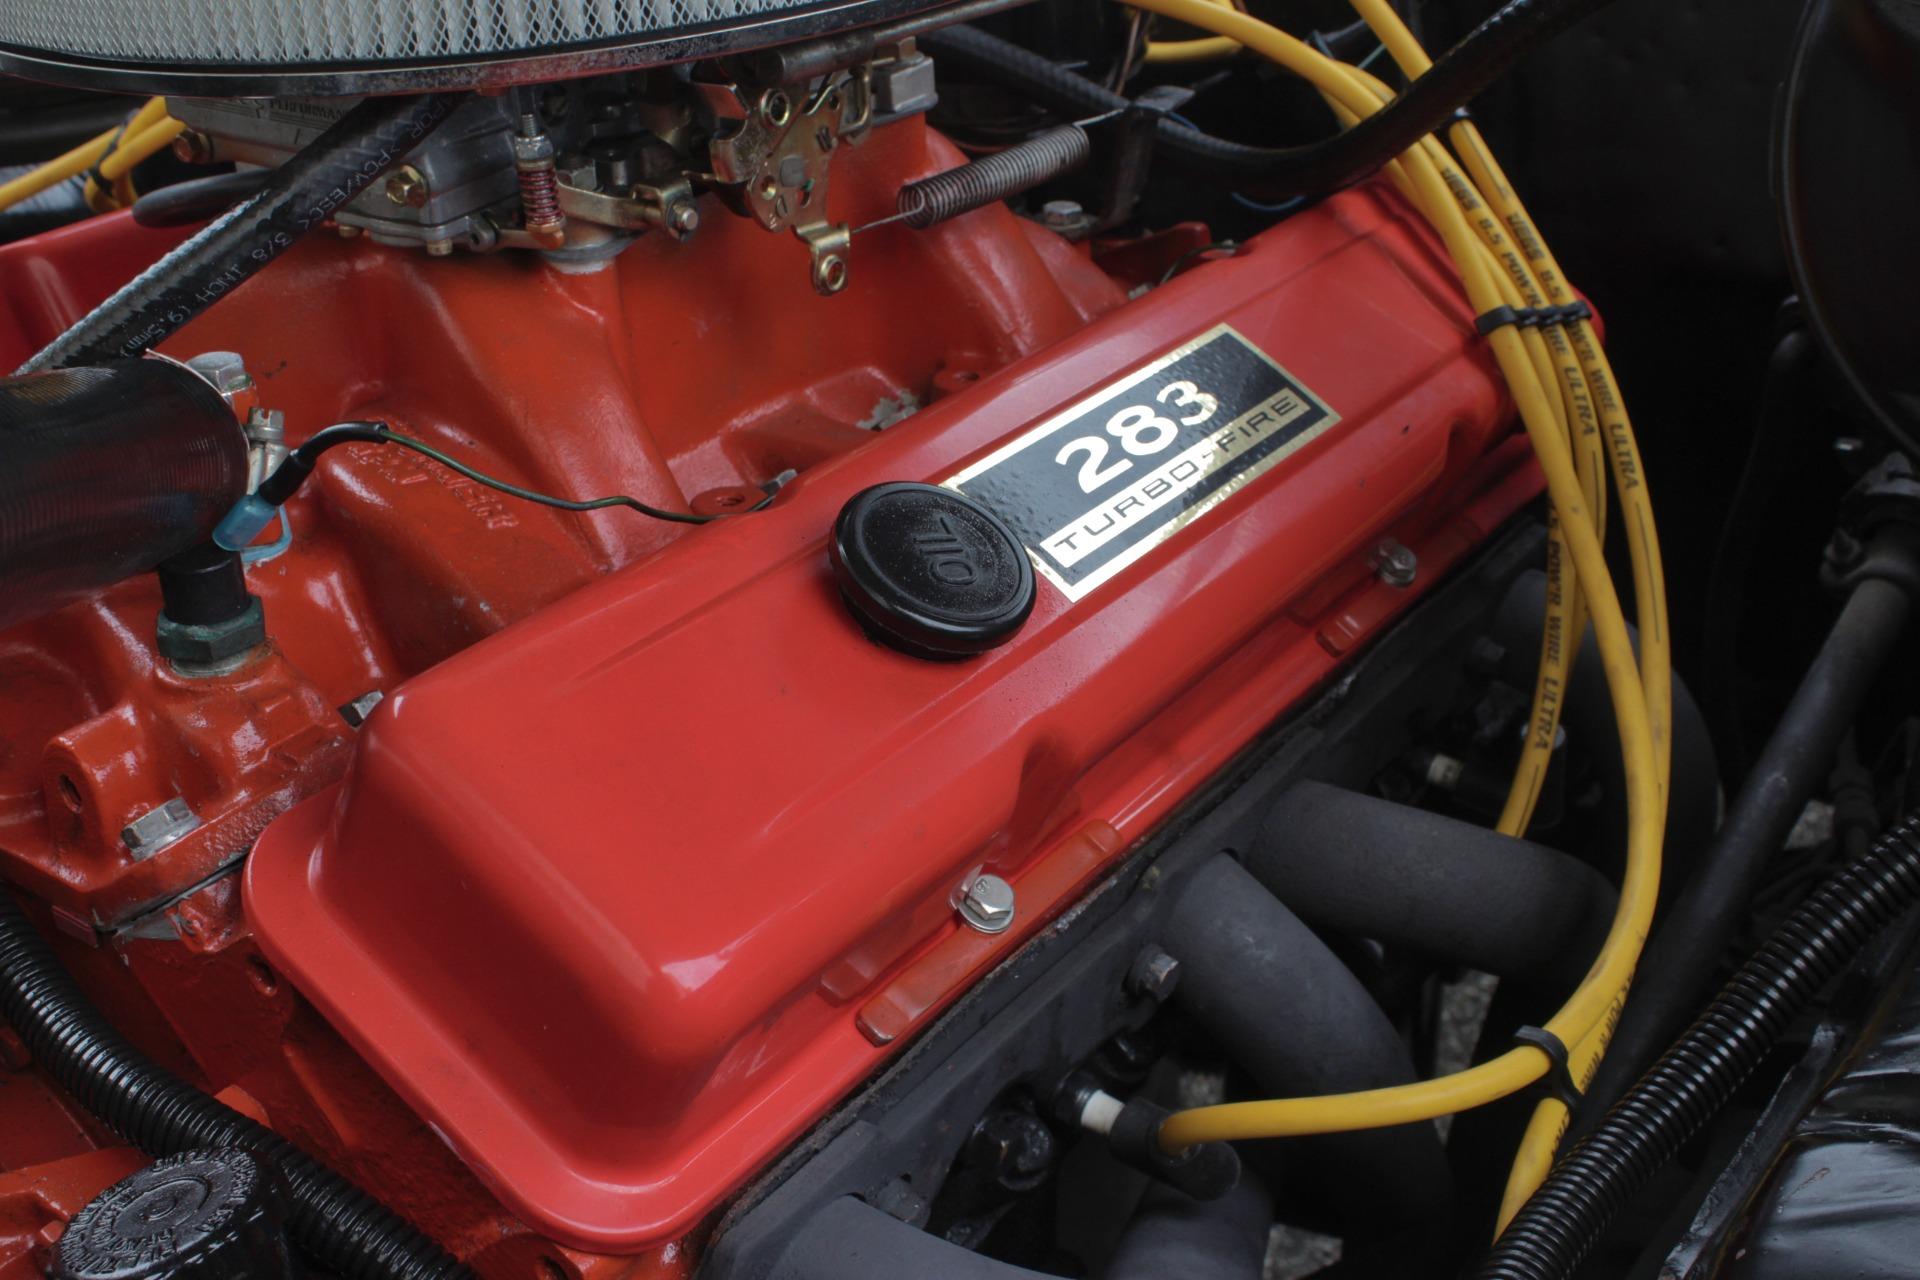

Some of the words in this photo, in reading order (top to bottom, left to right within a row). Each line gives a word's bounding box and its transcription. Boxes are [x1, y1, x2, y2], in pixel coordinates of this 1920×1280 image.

[252, 231, 292, 262] 3/8
[195, 263, 248, 303] INCH
[1563, 366, 1596, 436] ULTRA
[1054, 380, 1219, 494] 283
[1609, 423, 1639, 490] ULTRA
[1053, 395, 1300, 552] TURBO-FIRE
[911, 514, 979, 587] OIL
[1535, 676, 1559, 749] ULTRA
